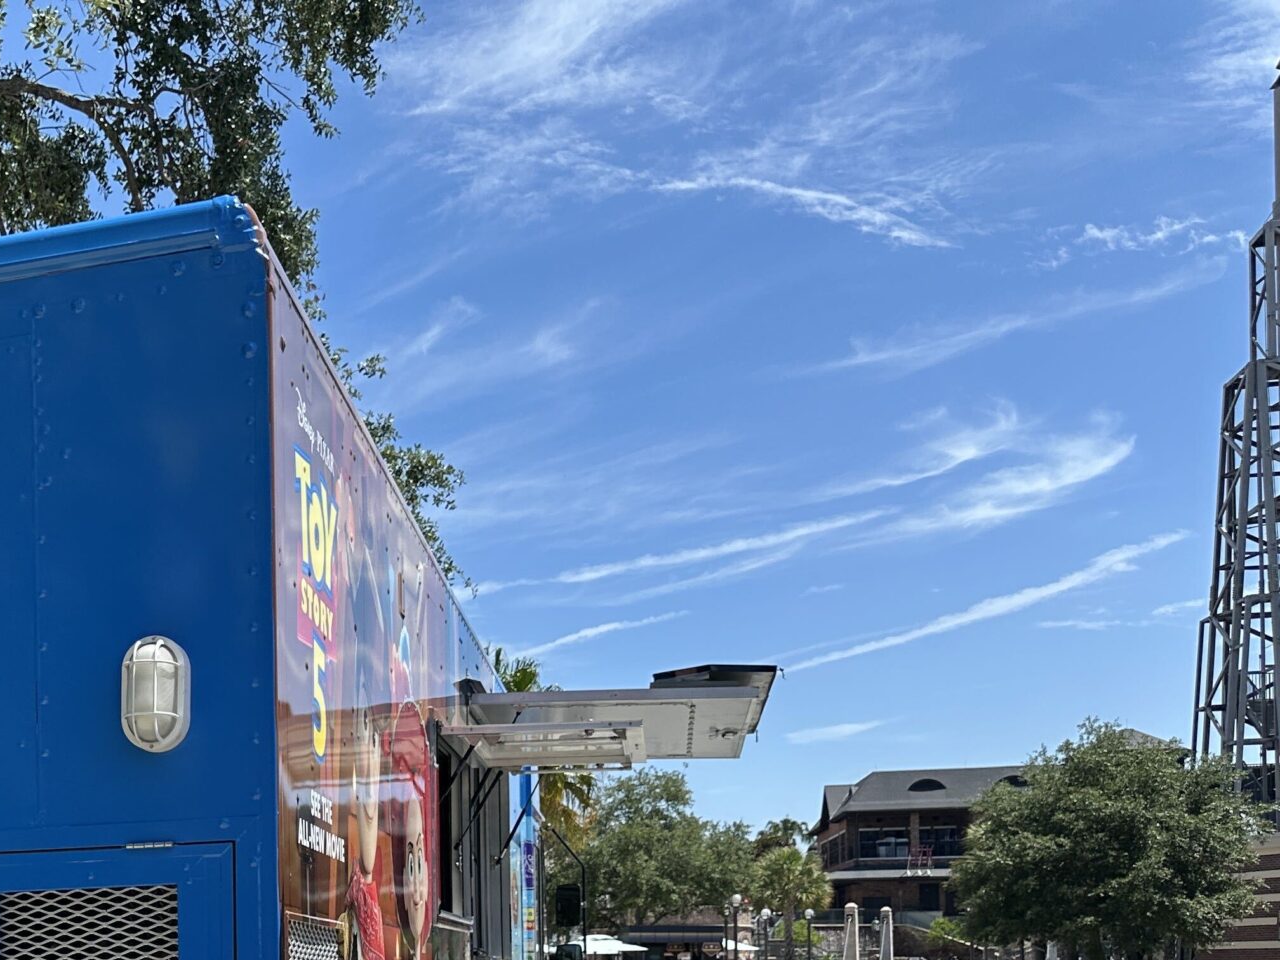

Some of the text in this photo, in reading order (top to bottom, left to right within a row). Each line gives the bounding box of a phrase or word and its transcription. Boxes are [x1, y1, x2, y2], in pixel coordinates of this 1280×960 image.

[294, 447, 338, 596] TOY
[300, 578, 334, 641] STORY
[313, 636, 327, 759] 5
[310, 789, 333, 826] SEE THE
[298, 818, 345, 863] ALL-NEW MOVIE
